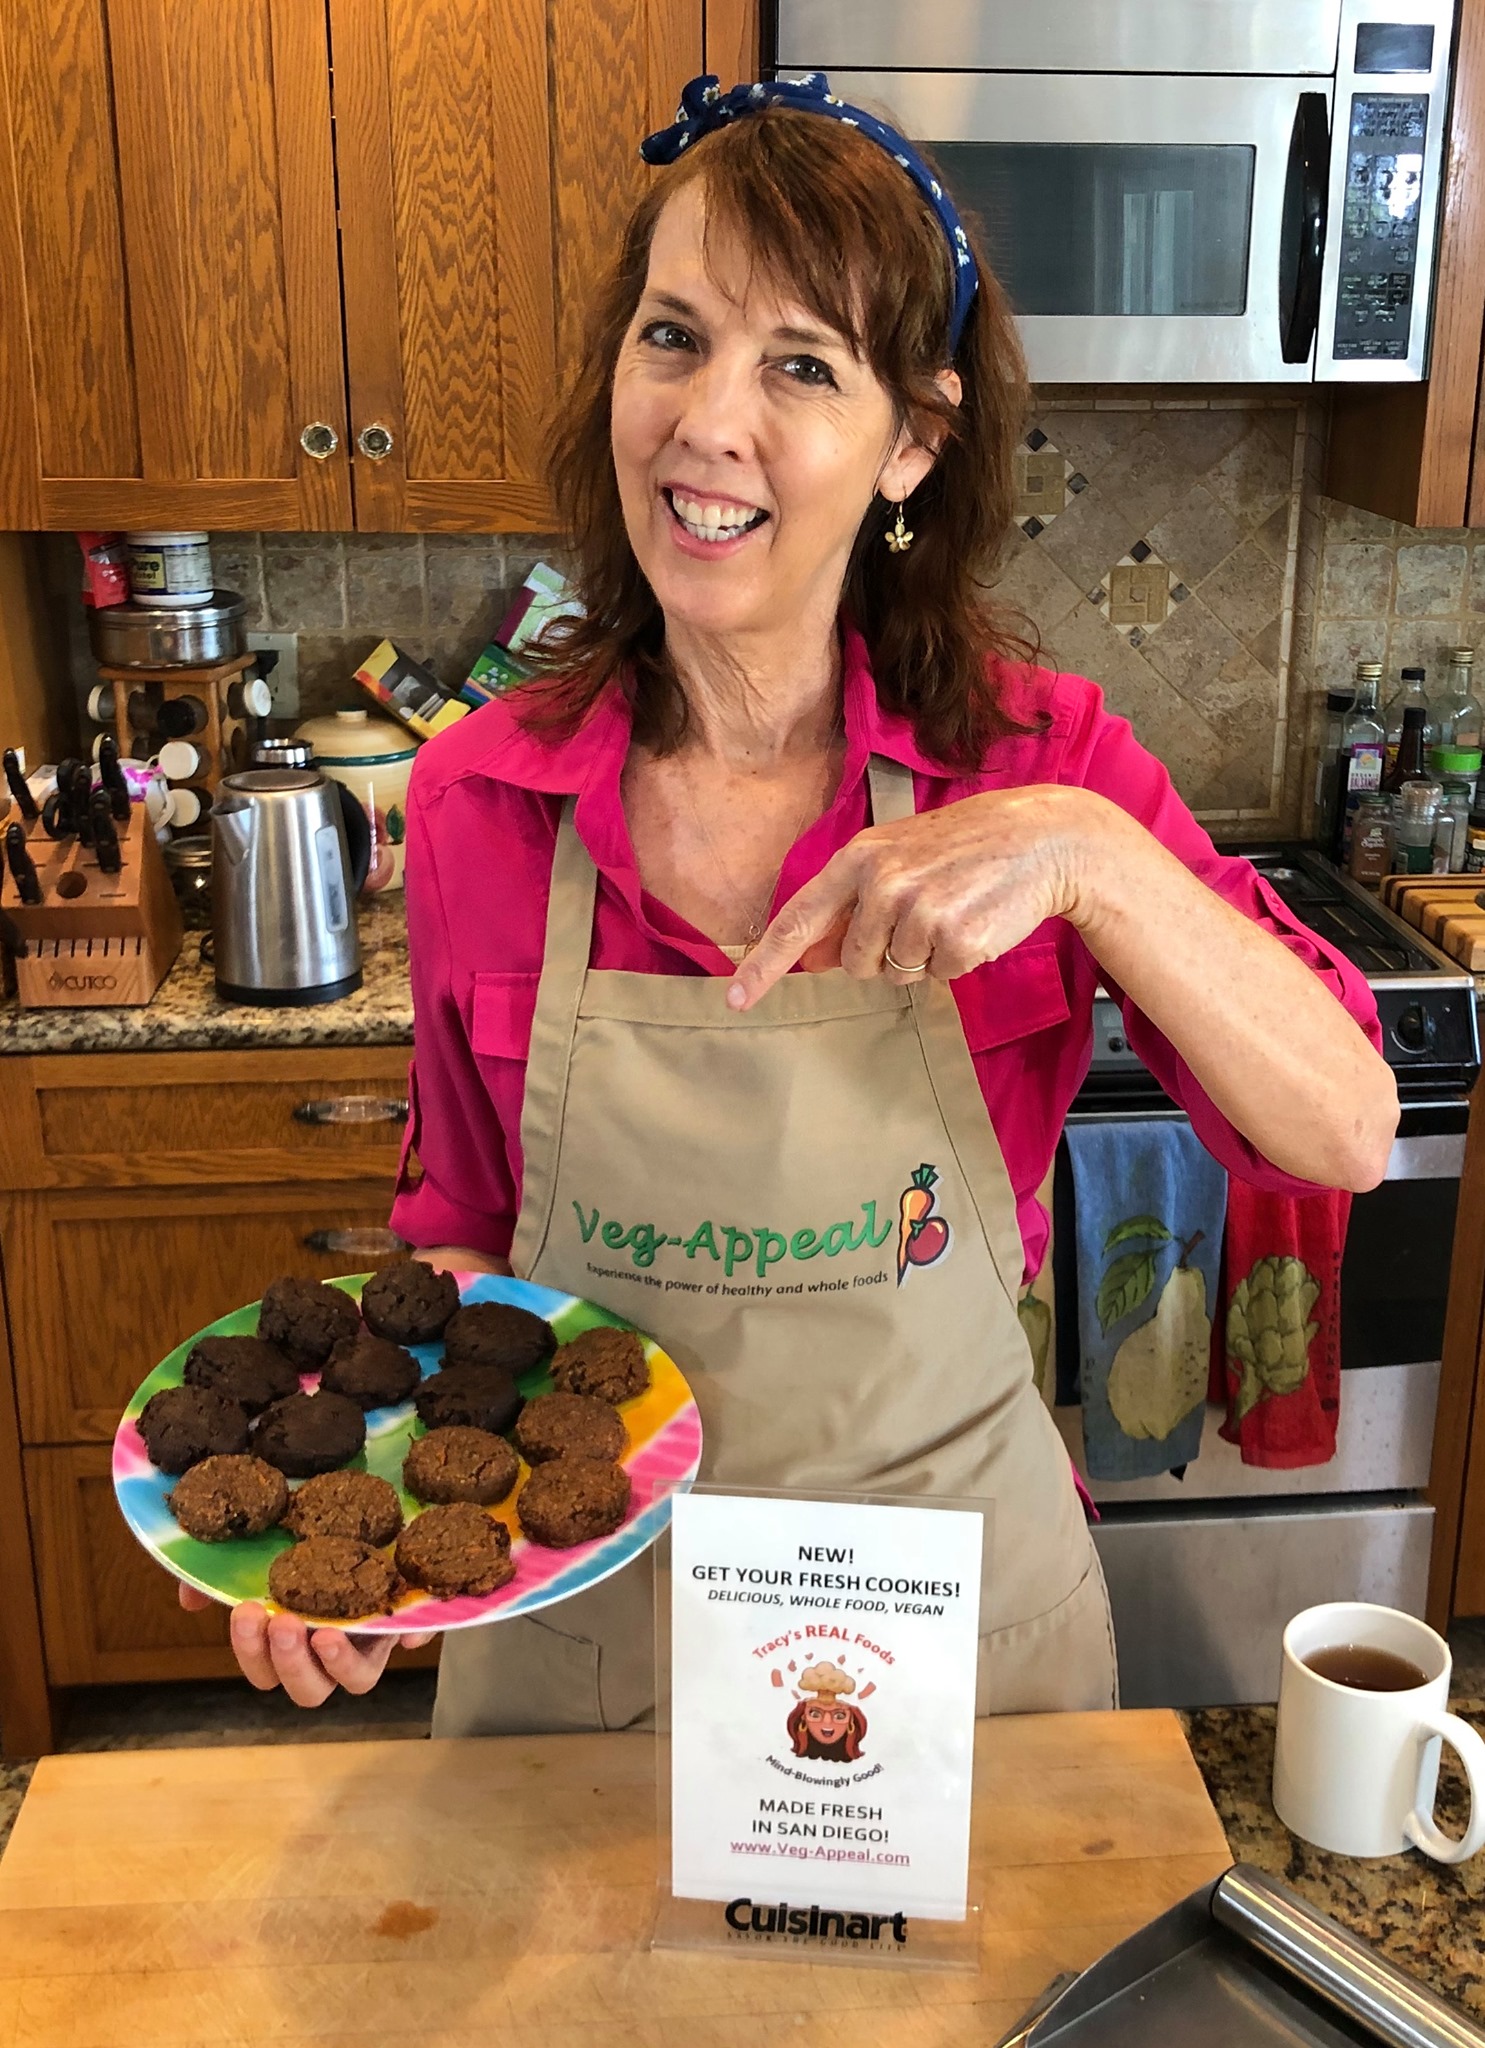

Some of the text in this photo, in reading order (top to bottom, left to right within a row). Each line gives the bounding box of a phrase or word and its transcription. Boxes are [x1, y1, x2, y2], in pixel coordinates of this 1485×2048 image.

[64, 975, 117, 991] CUTCO
[571, 1200, 893, 1278] Veg-Appeal
[587, 1262, 888, 1297] Experience the power of healthy and whole foods
[798, 1545, 854, 1564] NEW!
[692, 1565, 960, 1598] GET YOUR FRESH COOKIES!
[708, 1589, 944, 1616] DELICIOUS, WHOLE FOOD, VEGAN
[752, 1624, 896, 1665] Tracy's REAL Foods
[765, 1755, 884, 1788] Mind-Blowingly Good!
[759, 1798, 882, 1820] MADE FRESH
[752, 1819, 889, 1843] IN SAN DIEGO!
[730, 1841, 911, 1866] www.Veg-Appeal.com
[725, 1898, 907, 1943] Cuisinart
